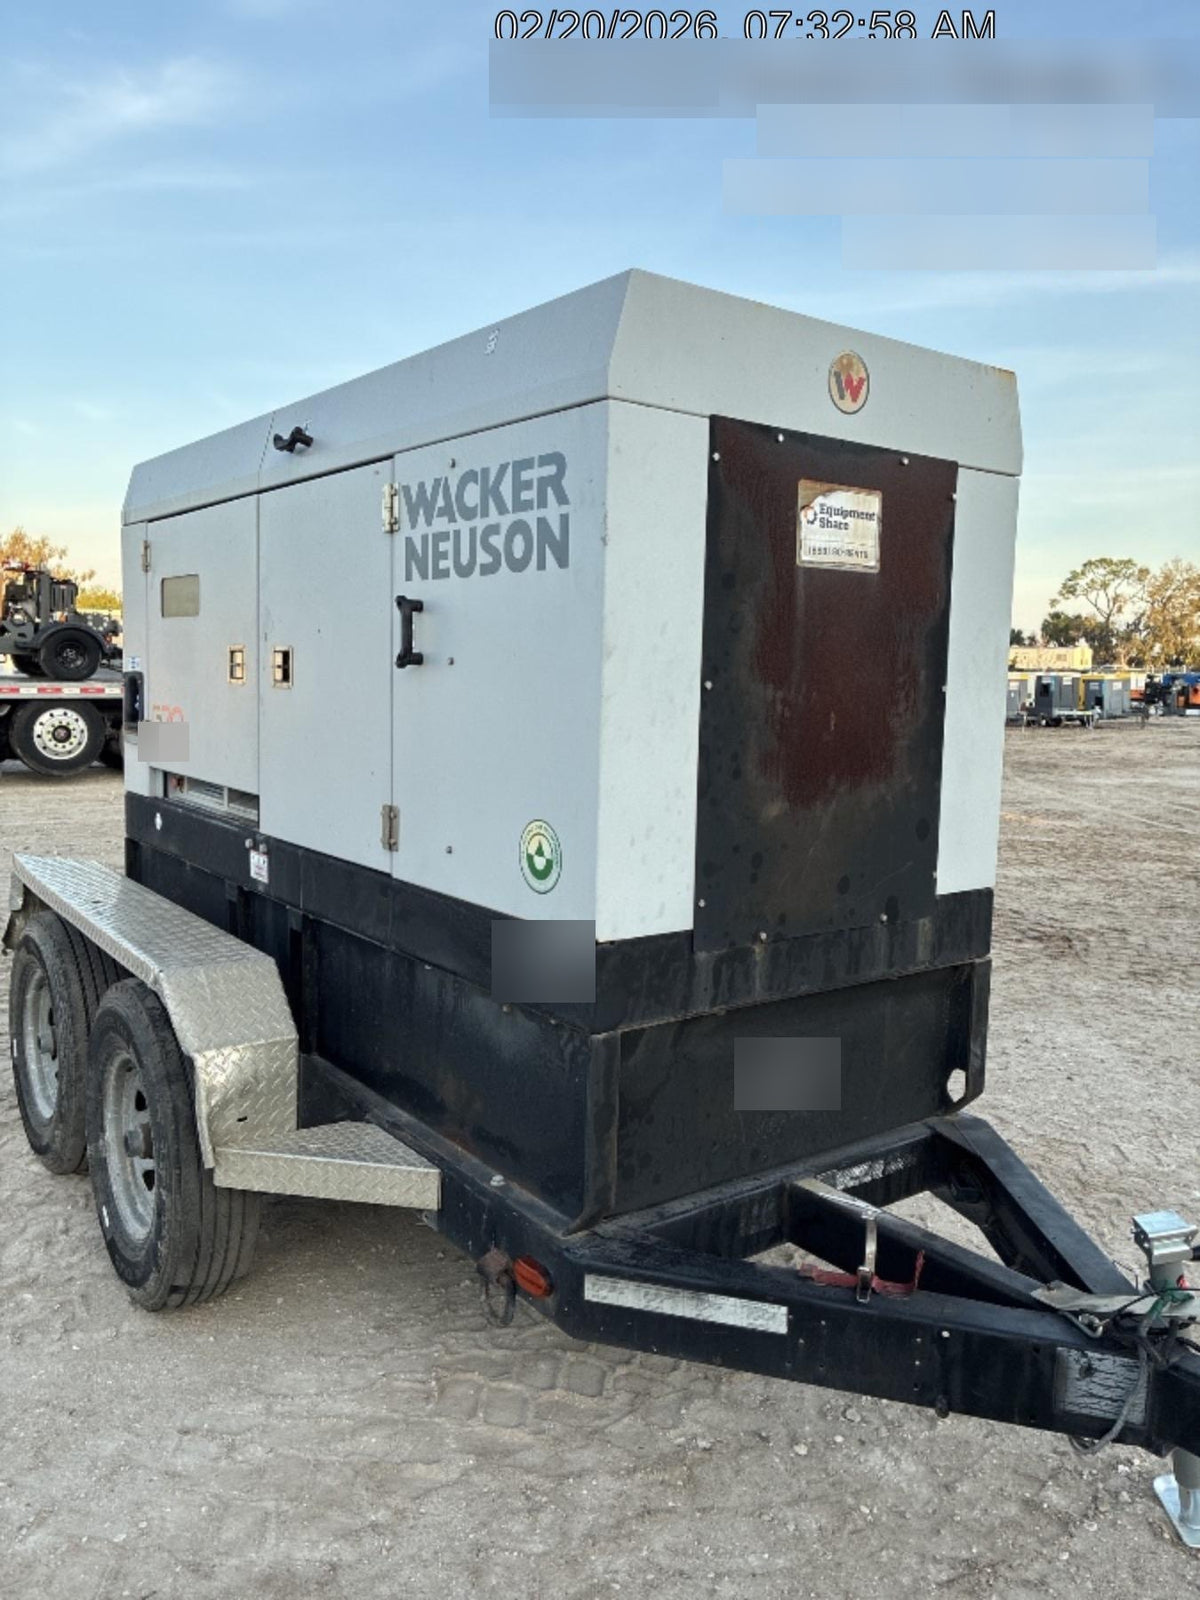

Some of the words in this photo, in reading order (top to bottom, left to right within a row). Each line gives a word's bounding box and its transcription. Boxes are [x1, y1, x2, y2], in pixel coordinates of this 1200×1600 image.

[401, 451, 571, 530] WACKER
[819, 502, 876, 521] Equipment
[819, 516, 850, 531] Share
[404, 512, 570, 582] NEUSON
